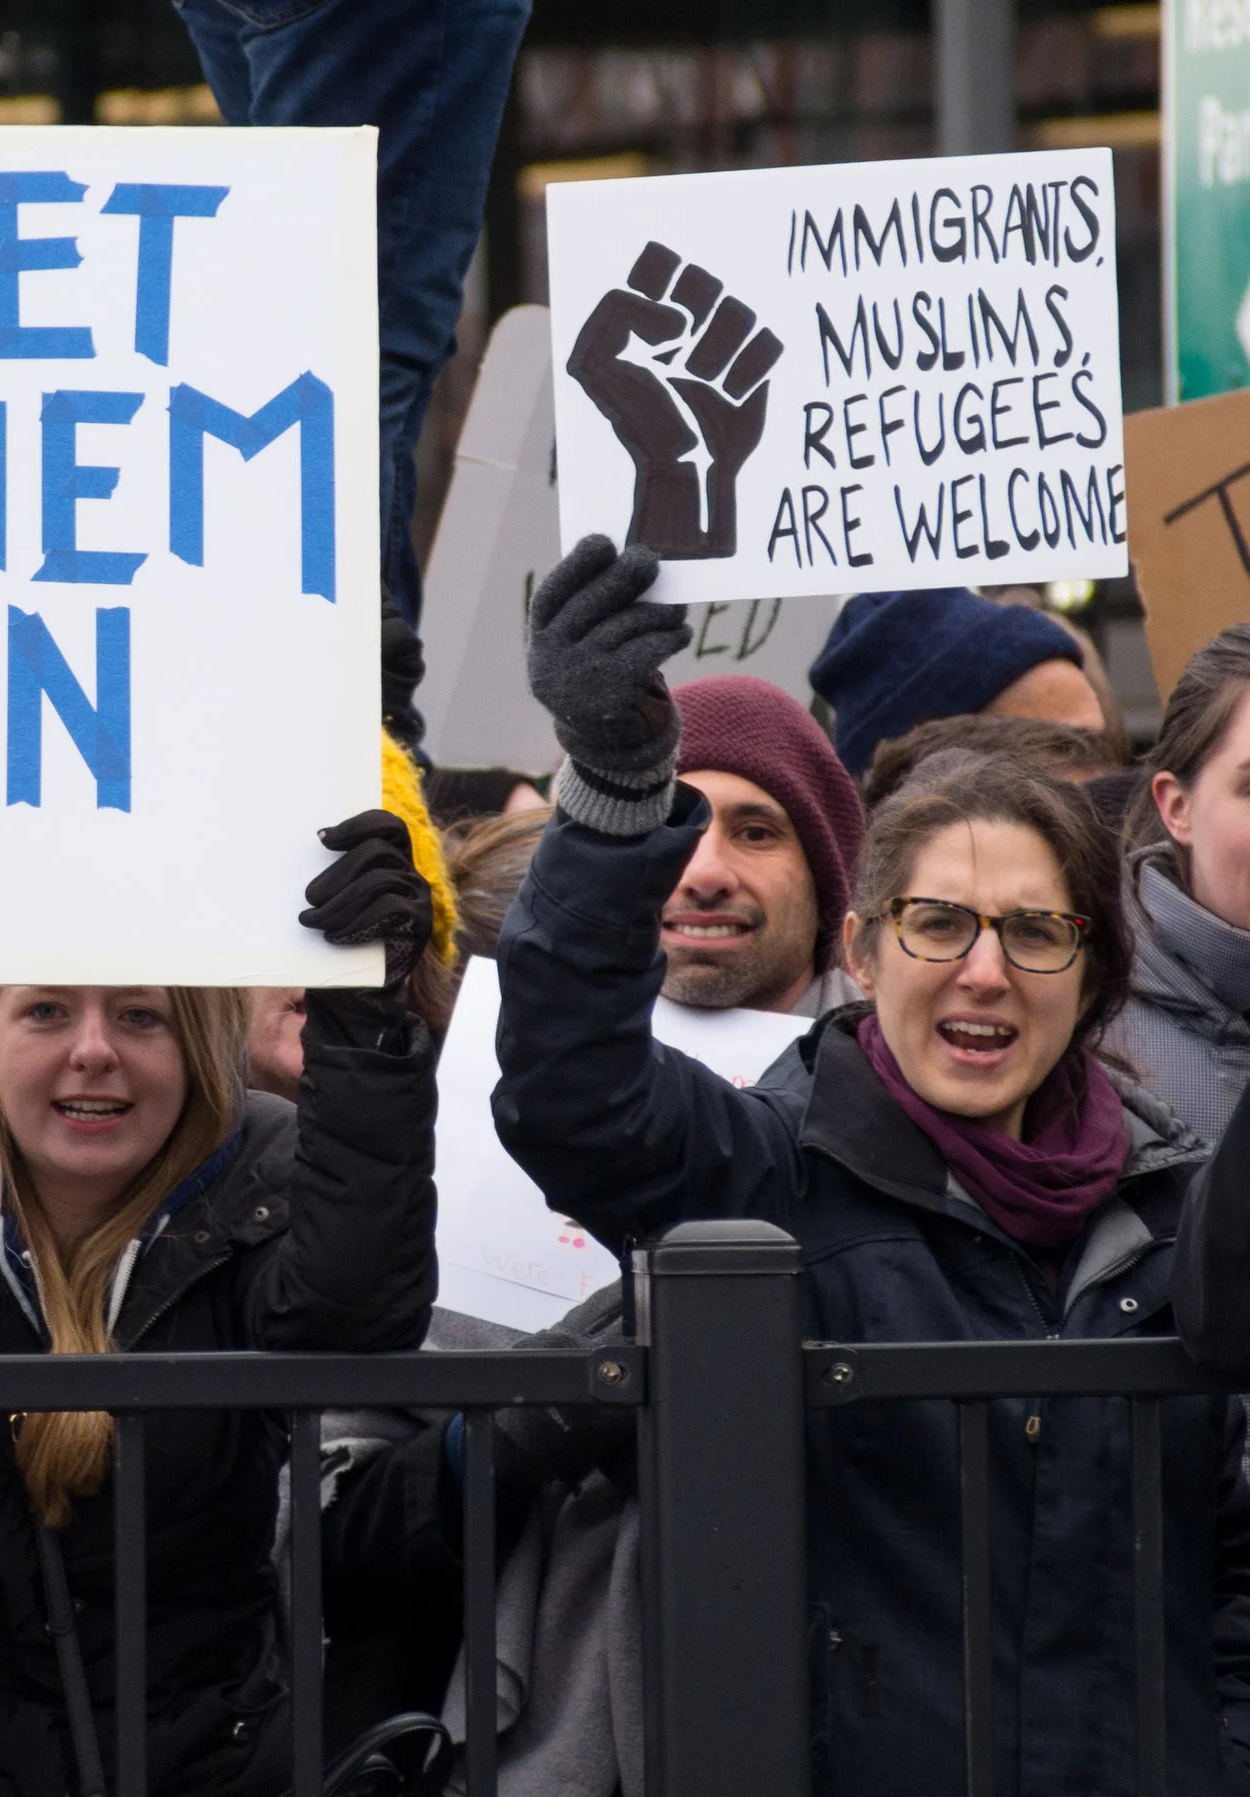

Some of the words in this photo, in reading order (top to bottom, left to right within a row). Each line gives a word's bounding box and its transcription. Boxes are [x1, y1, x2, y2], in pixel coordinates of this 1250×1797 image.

[786, 174, 1105, 278] IMMIGRANTS,
[814, 283, 1092, 387] MUSLIMS,
[803, 369, 1107, 470] REFUGEES
[767, 483, 873, 570] ARE
[894, 463, 1126, 564] WELCOME
